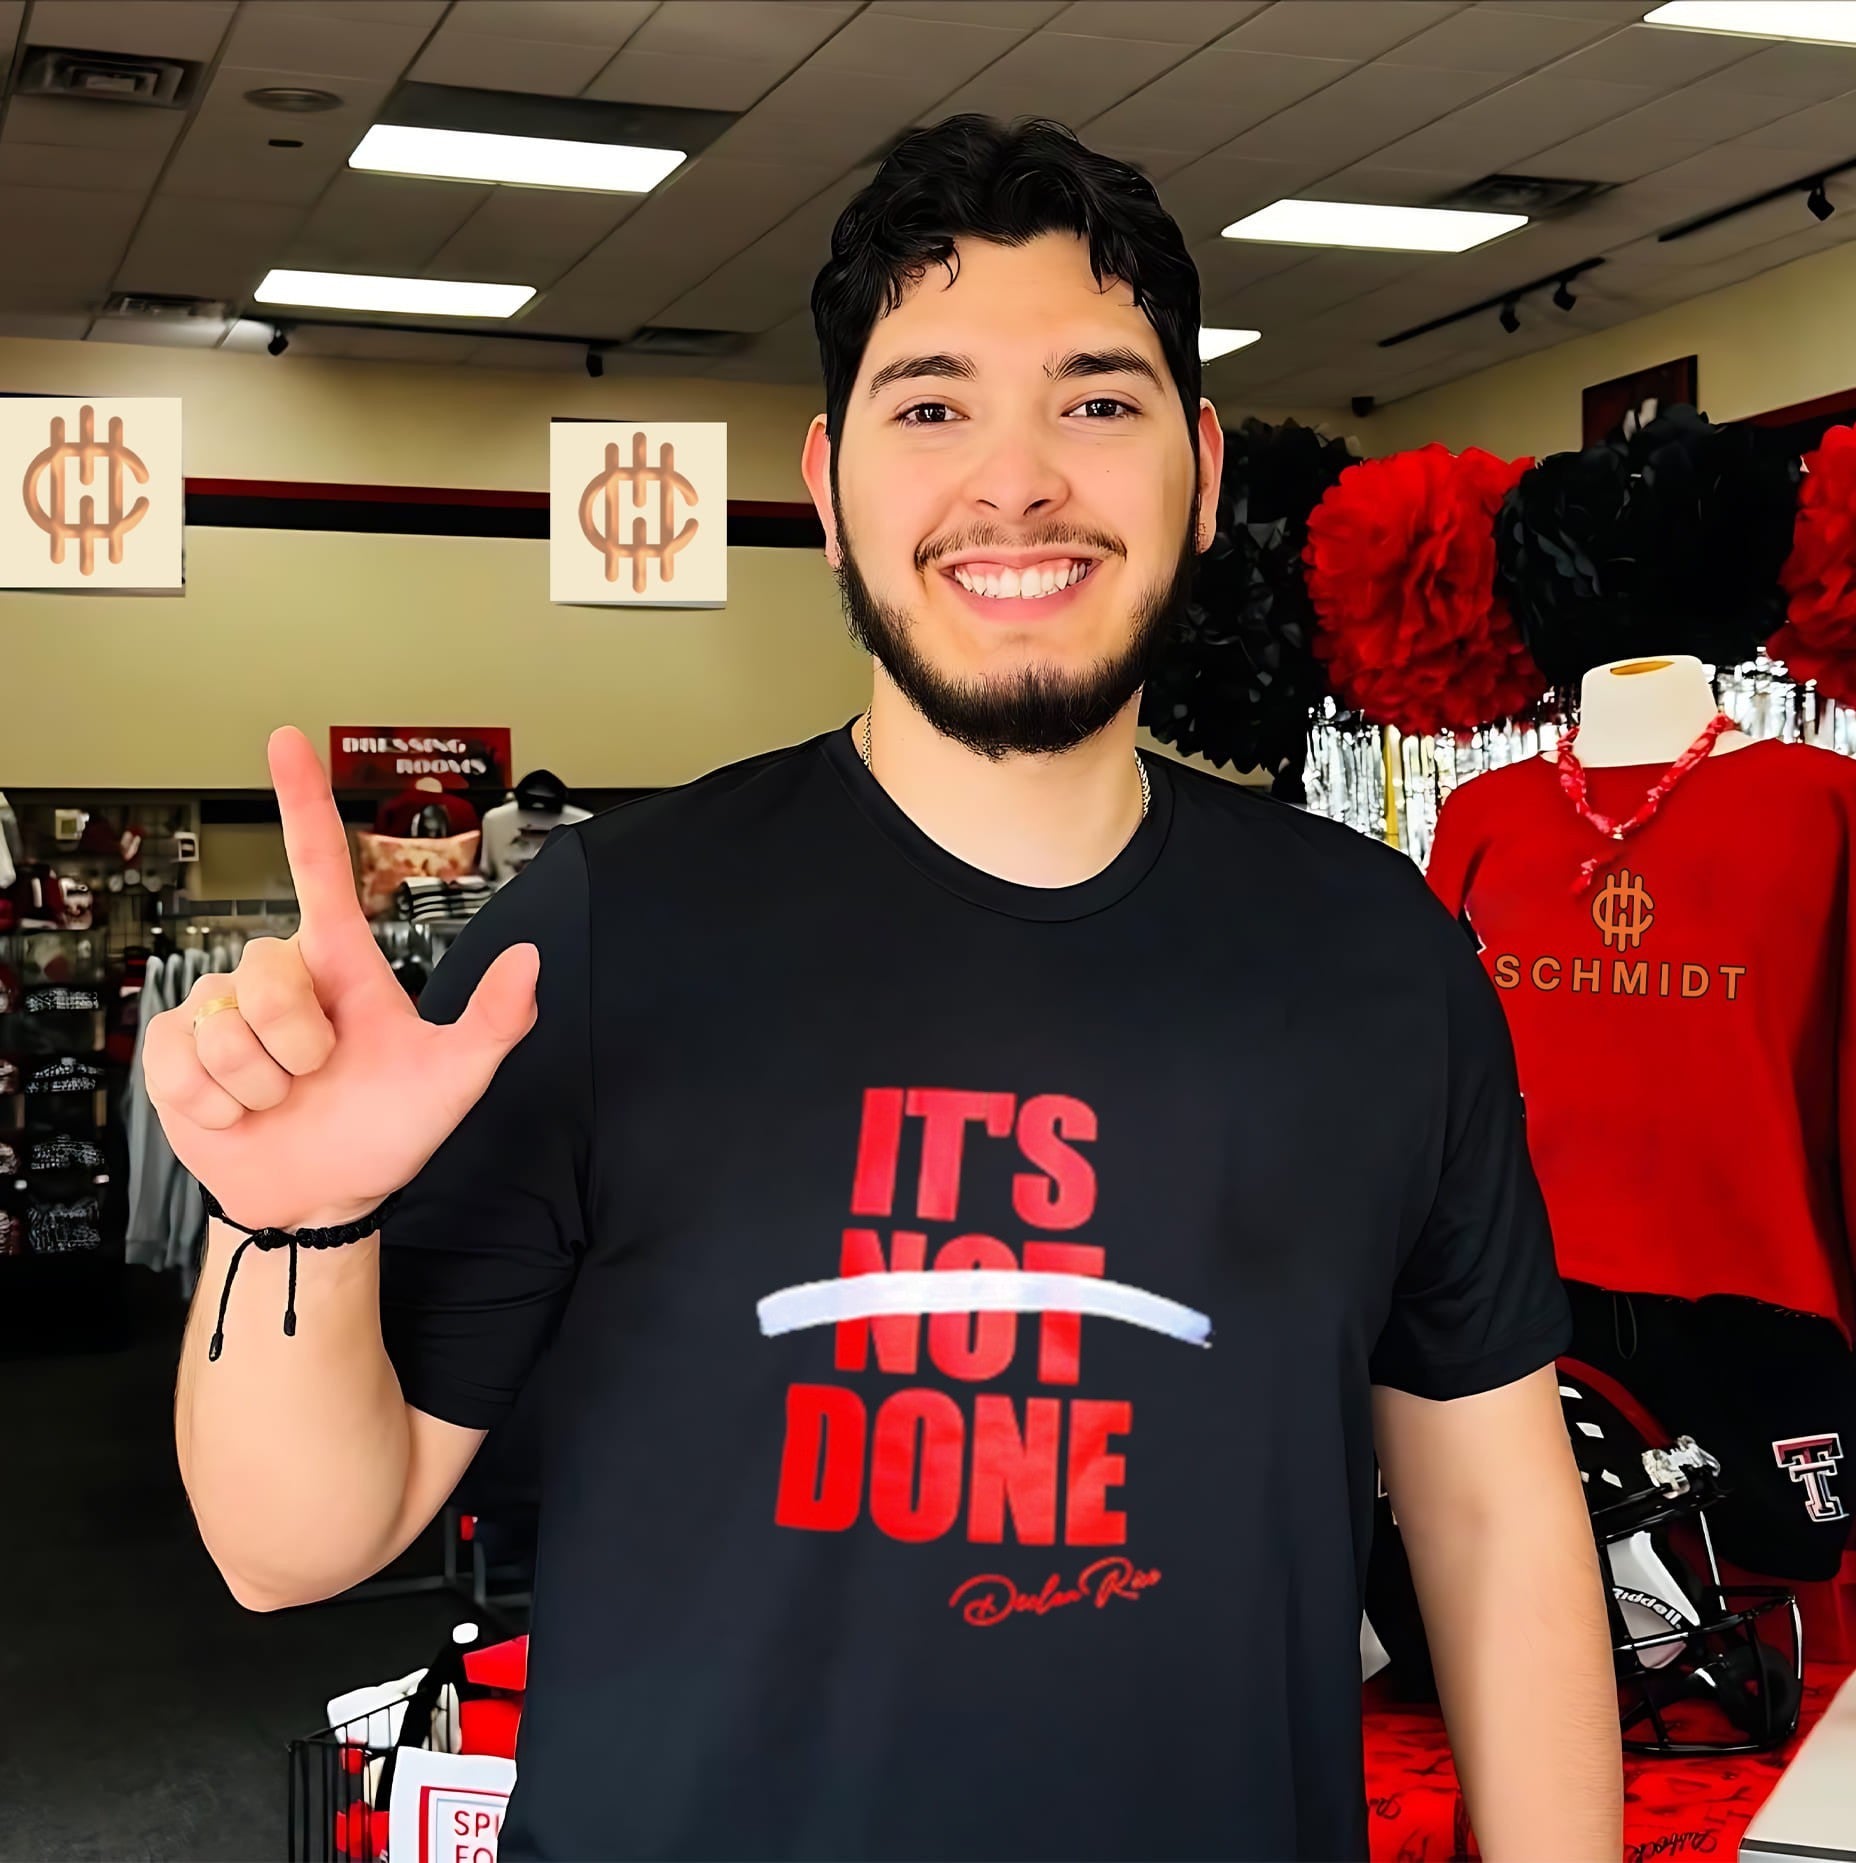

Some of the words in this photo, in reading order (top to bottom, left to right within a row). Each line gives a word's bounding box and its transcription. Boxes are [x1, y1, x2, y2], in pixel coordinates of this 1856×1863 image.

[1494, 954, 1746, 1001] SCHMIDT
[850, 1087, 1098, 1231] IT'S
[834, 1228, 1106, 1385] NOT
[774, 1383, 1134, 1547] DONE
